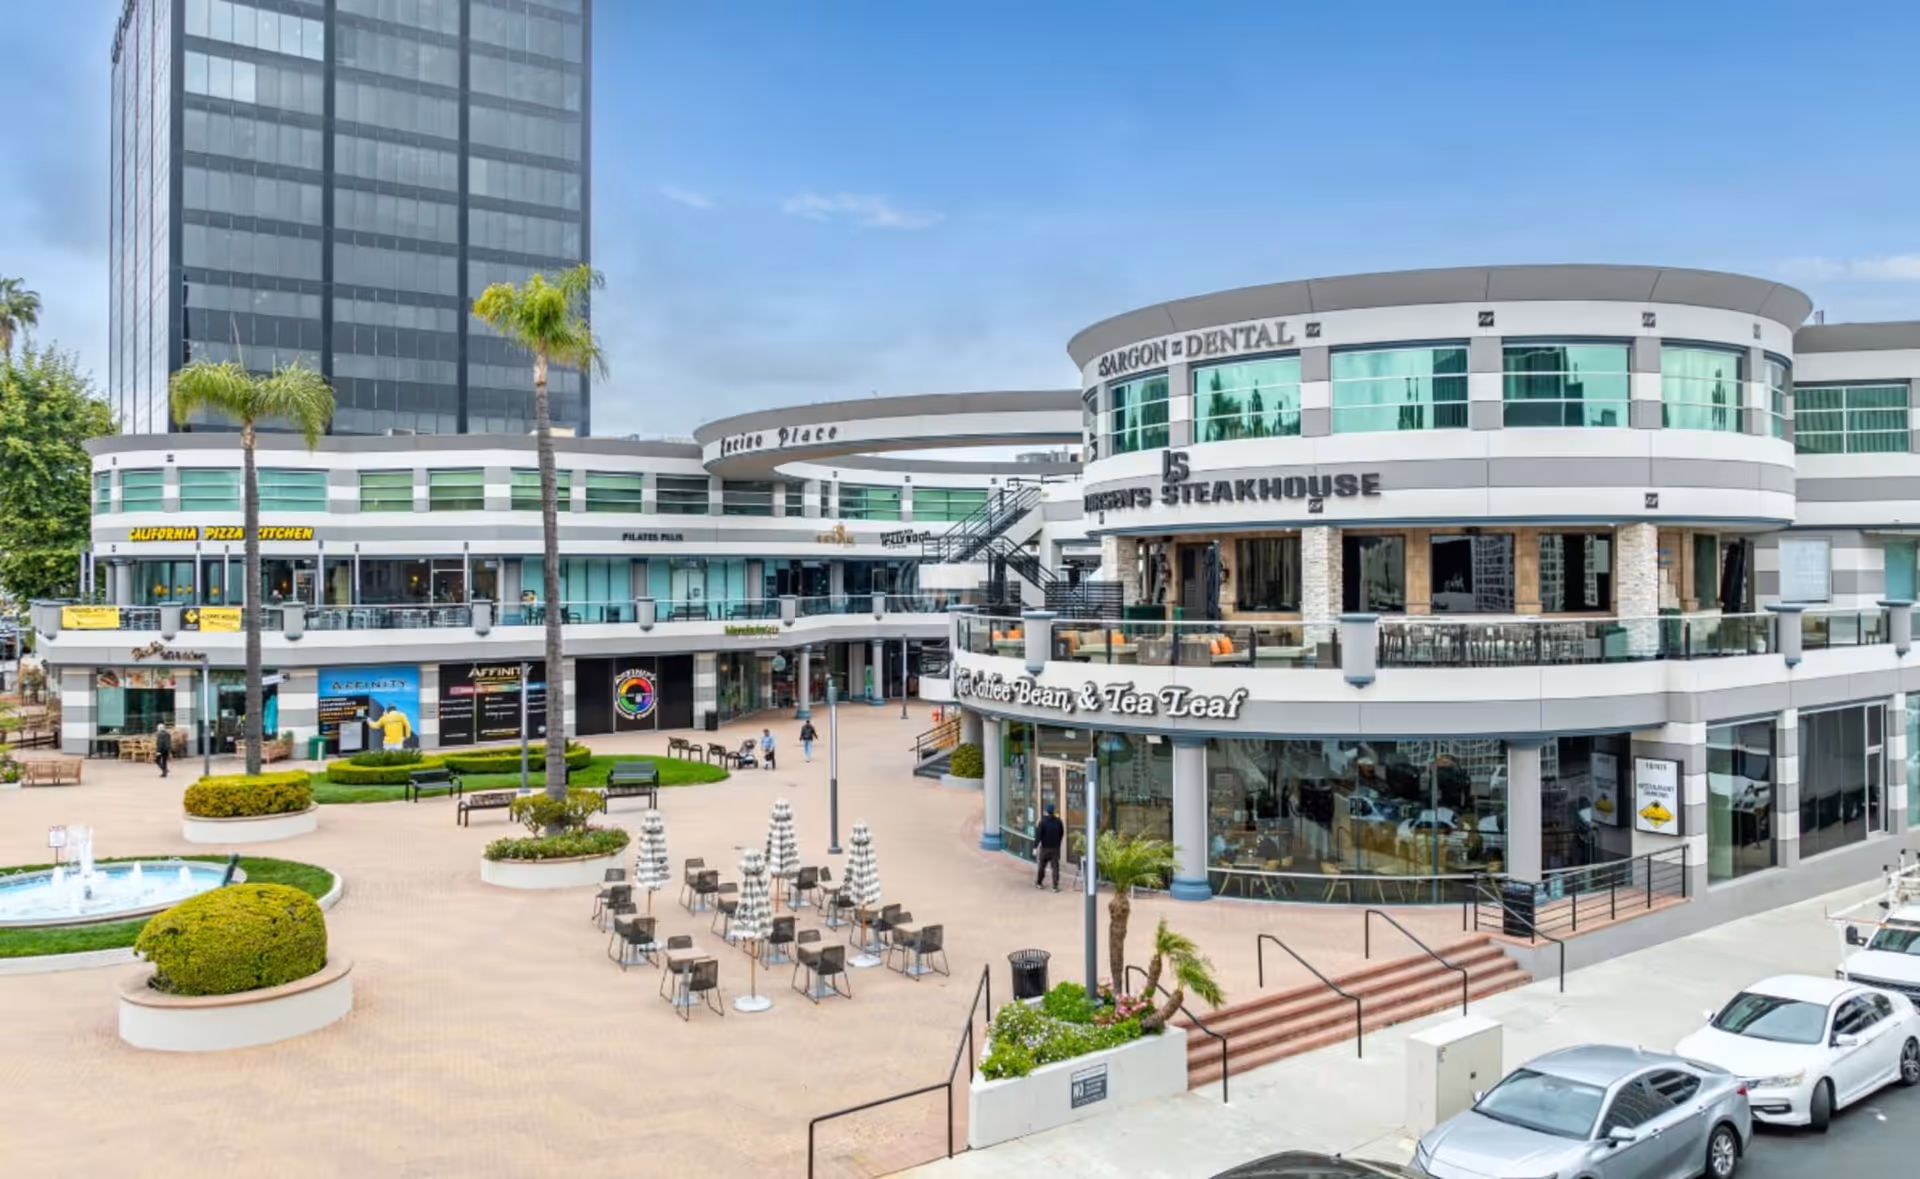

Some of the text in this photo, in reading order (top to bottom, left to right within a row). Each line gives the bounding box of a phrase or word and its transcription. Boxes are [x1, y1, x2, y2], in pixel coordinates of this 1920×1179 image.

[1099, 321, 1294, 377] SARGON DENTAL
[779, 427, 837, 447] Place
[1161, 473, 1381, 505] STEAKHOUSE
[128, 526, 198, 542] CALIFORNIA
[204, 526, 245, 541] PIZZA
[622, 532, 659, 541] PILATES
[332, 680, 406, 690] AFFINITY
[971, 670, 1012, 702] Coffee
[1012, 677, 1073, 713] Bean
[1077, 681, 1099, 712] &
[1104, 682, 1155, 715] Tea
[1159, 686, 1248, 719] Leaf
